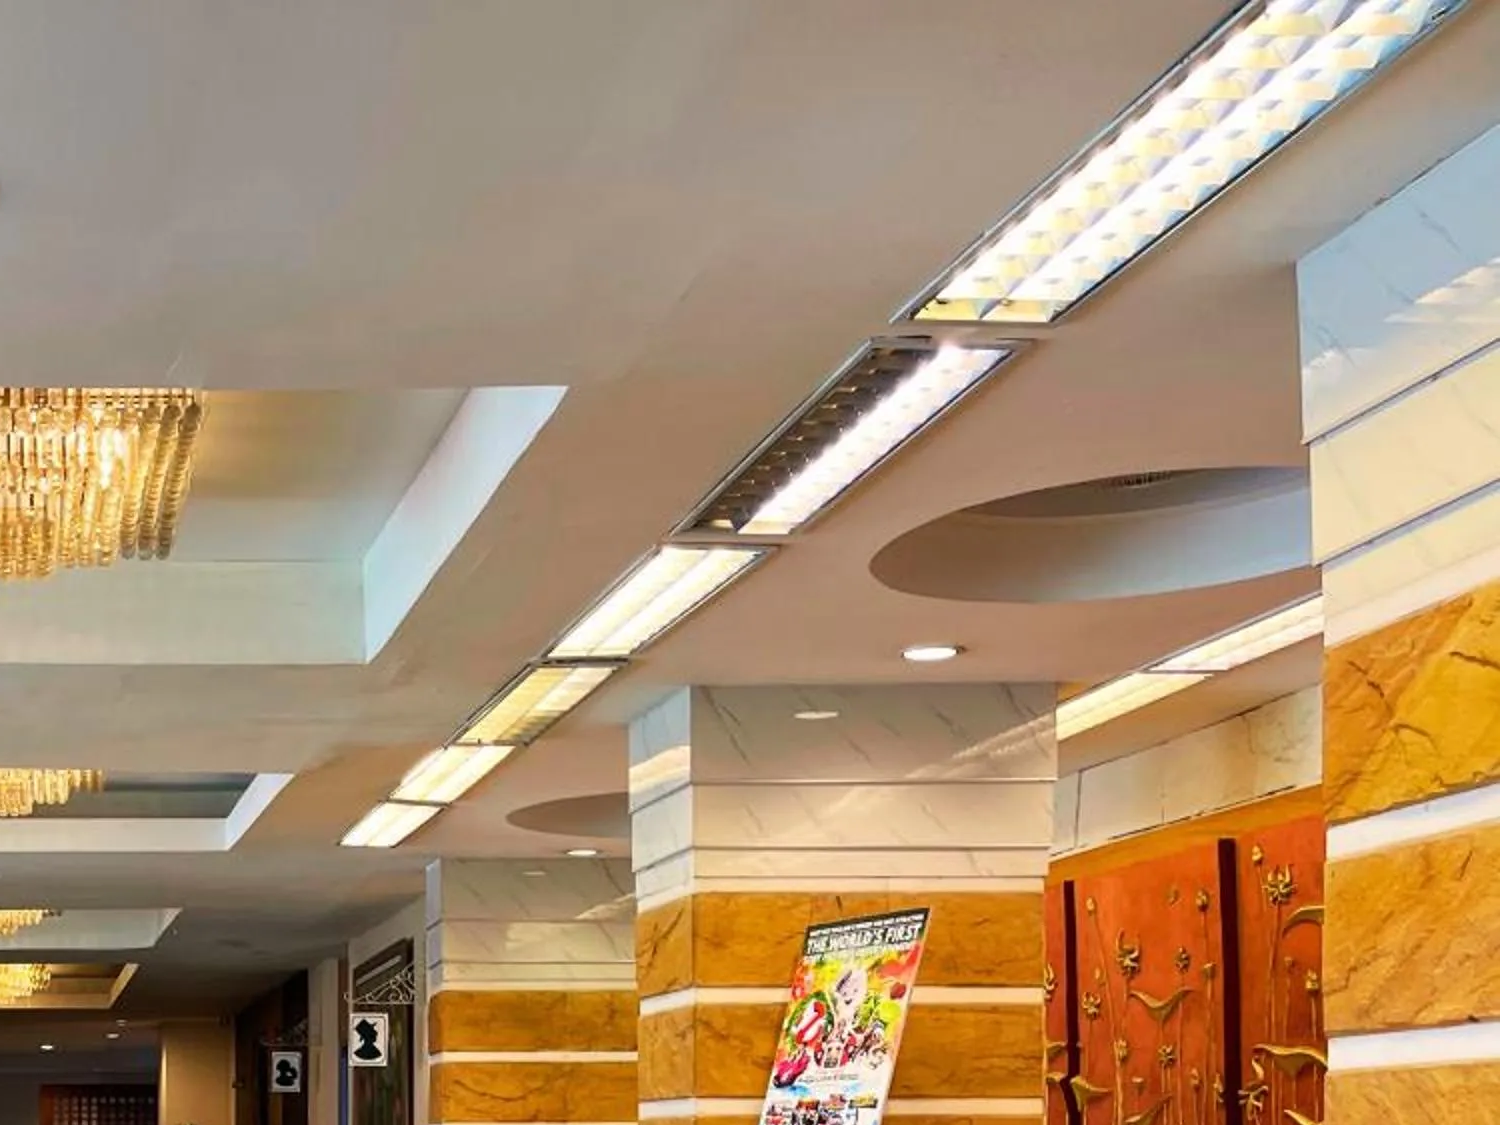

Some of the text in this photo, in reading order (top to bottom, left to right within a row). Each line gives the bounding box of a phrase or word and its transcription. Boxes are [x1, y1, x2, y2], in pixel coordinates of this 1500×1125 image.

[807, 935, 829, 955] THE
[829, 927, 885, 952] WORLD'S
[885, 921, 923, 943] FIRST
